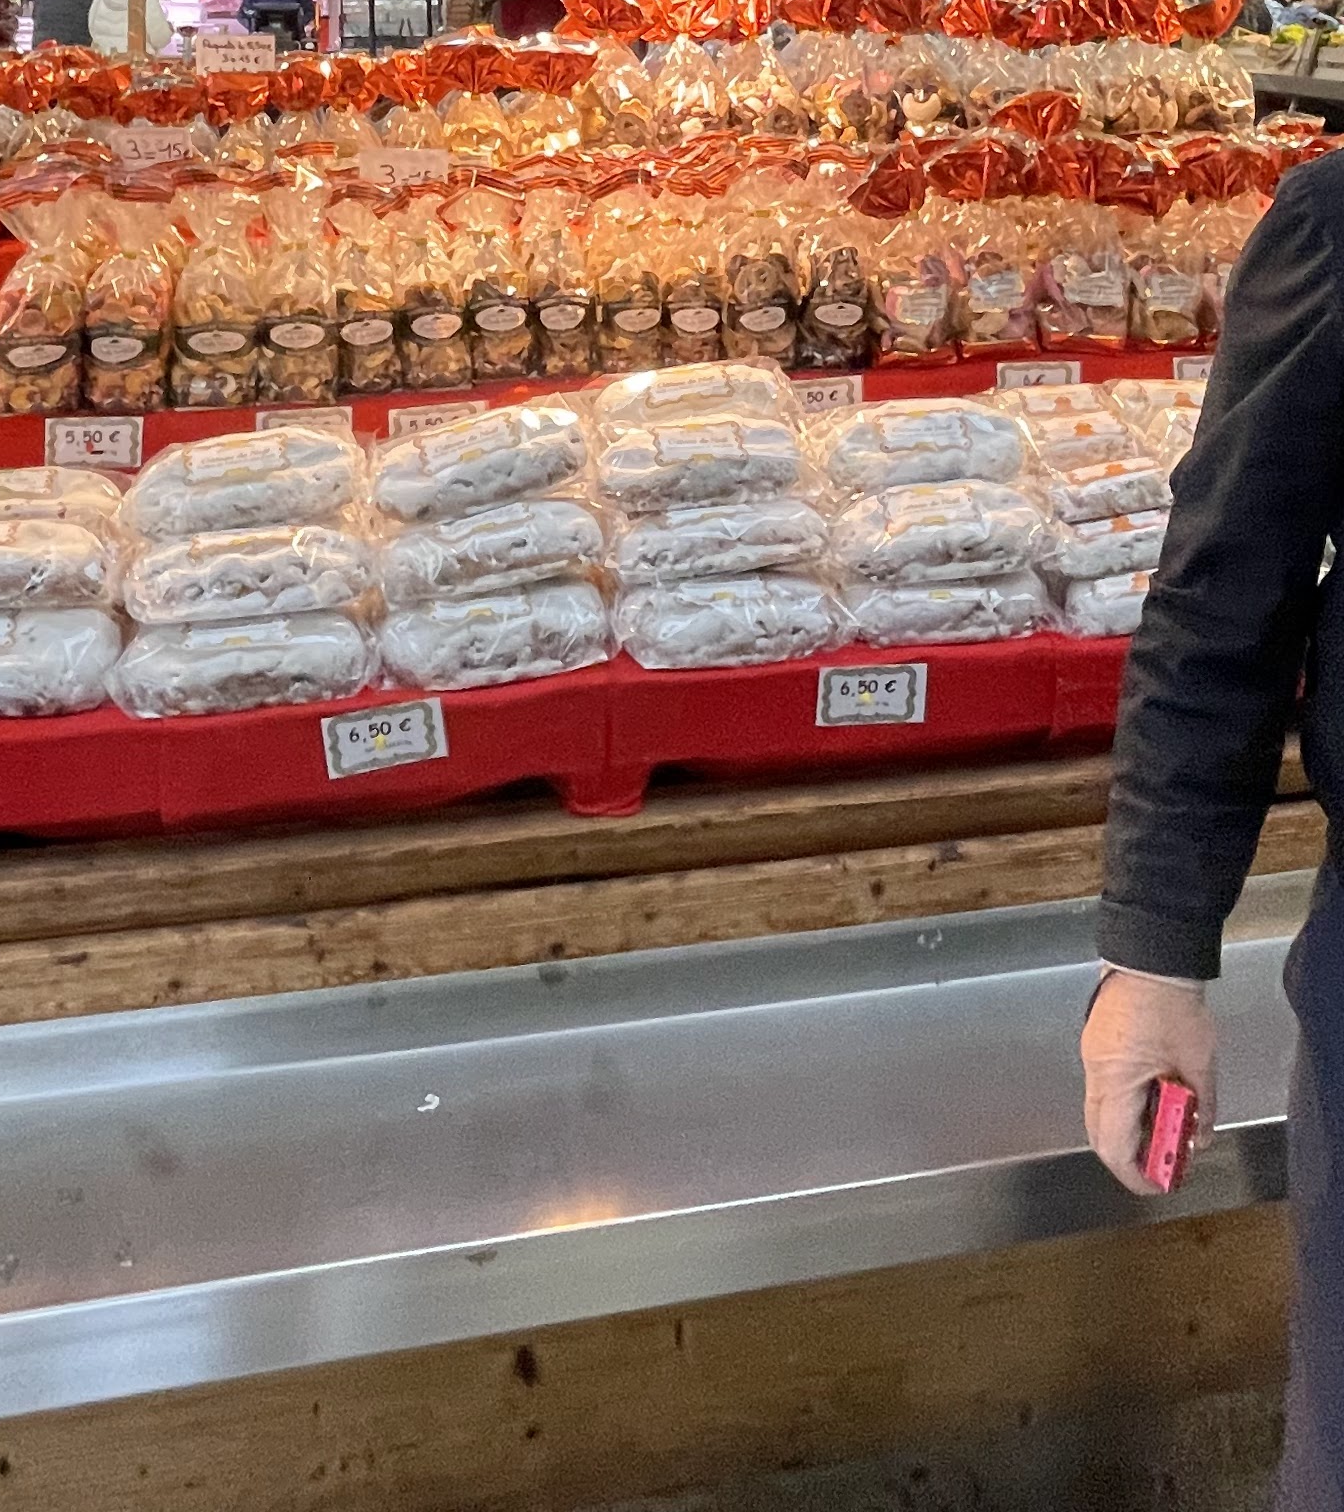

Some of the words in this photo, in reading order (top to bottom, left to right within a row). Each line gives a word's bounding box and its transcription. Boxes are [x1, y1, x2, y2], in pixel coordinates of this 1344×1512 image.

[123, 138, 143, 161] 3
[64, 429, 103, 448] 5,50
[108, 430, 121, 444] €
[839, 679, 879, 698] 6,50
[884, 679, 898, 694] €
[348, 720, 393, 744] 6,50
[399, 718, 412, 733] €
